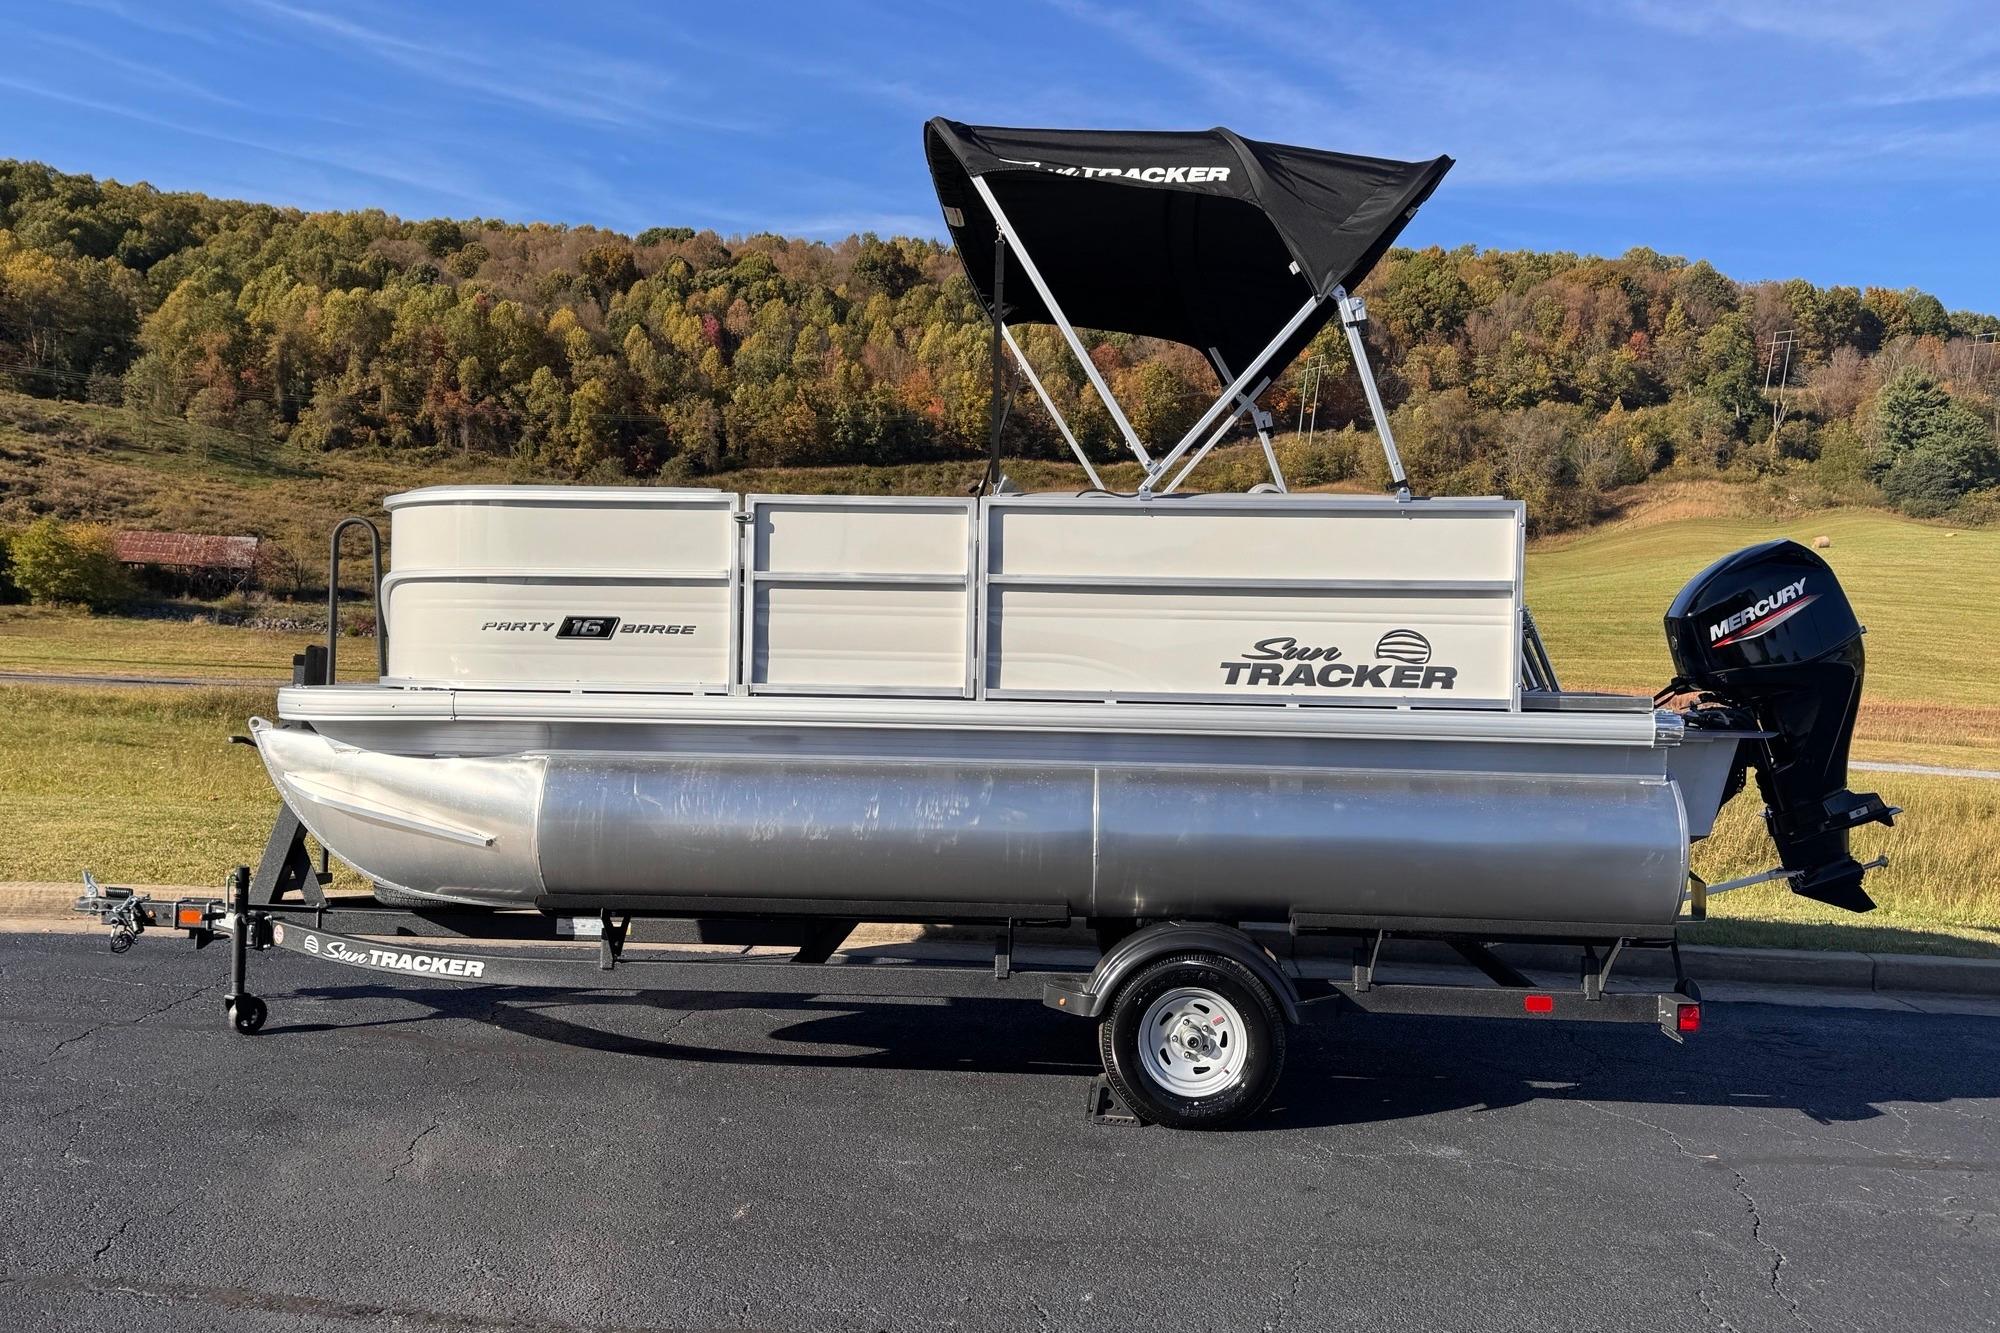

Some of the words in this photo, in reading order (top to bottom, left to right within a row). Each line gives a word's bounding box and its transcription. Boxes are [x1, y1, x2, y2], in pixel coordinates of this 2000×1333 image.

[1709, 577, 1806, 641] MERCURY
[481, 621, 555, 632] PARTY
[571, 619, 603, 636] 16
[620, 623, 697, 635] BARGE
[1241, 636, 1342, 662] Sun
[1220, 661, 1458, 690] TRACKER
[322, 941, 368, 965] Sun
[369, 949, 485, 978] TRACKER
